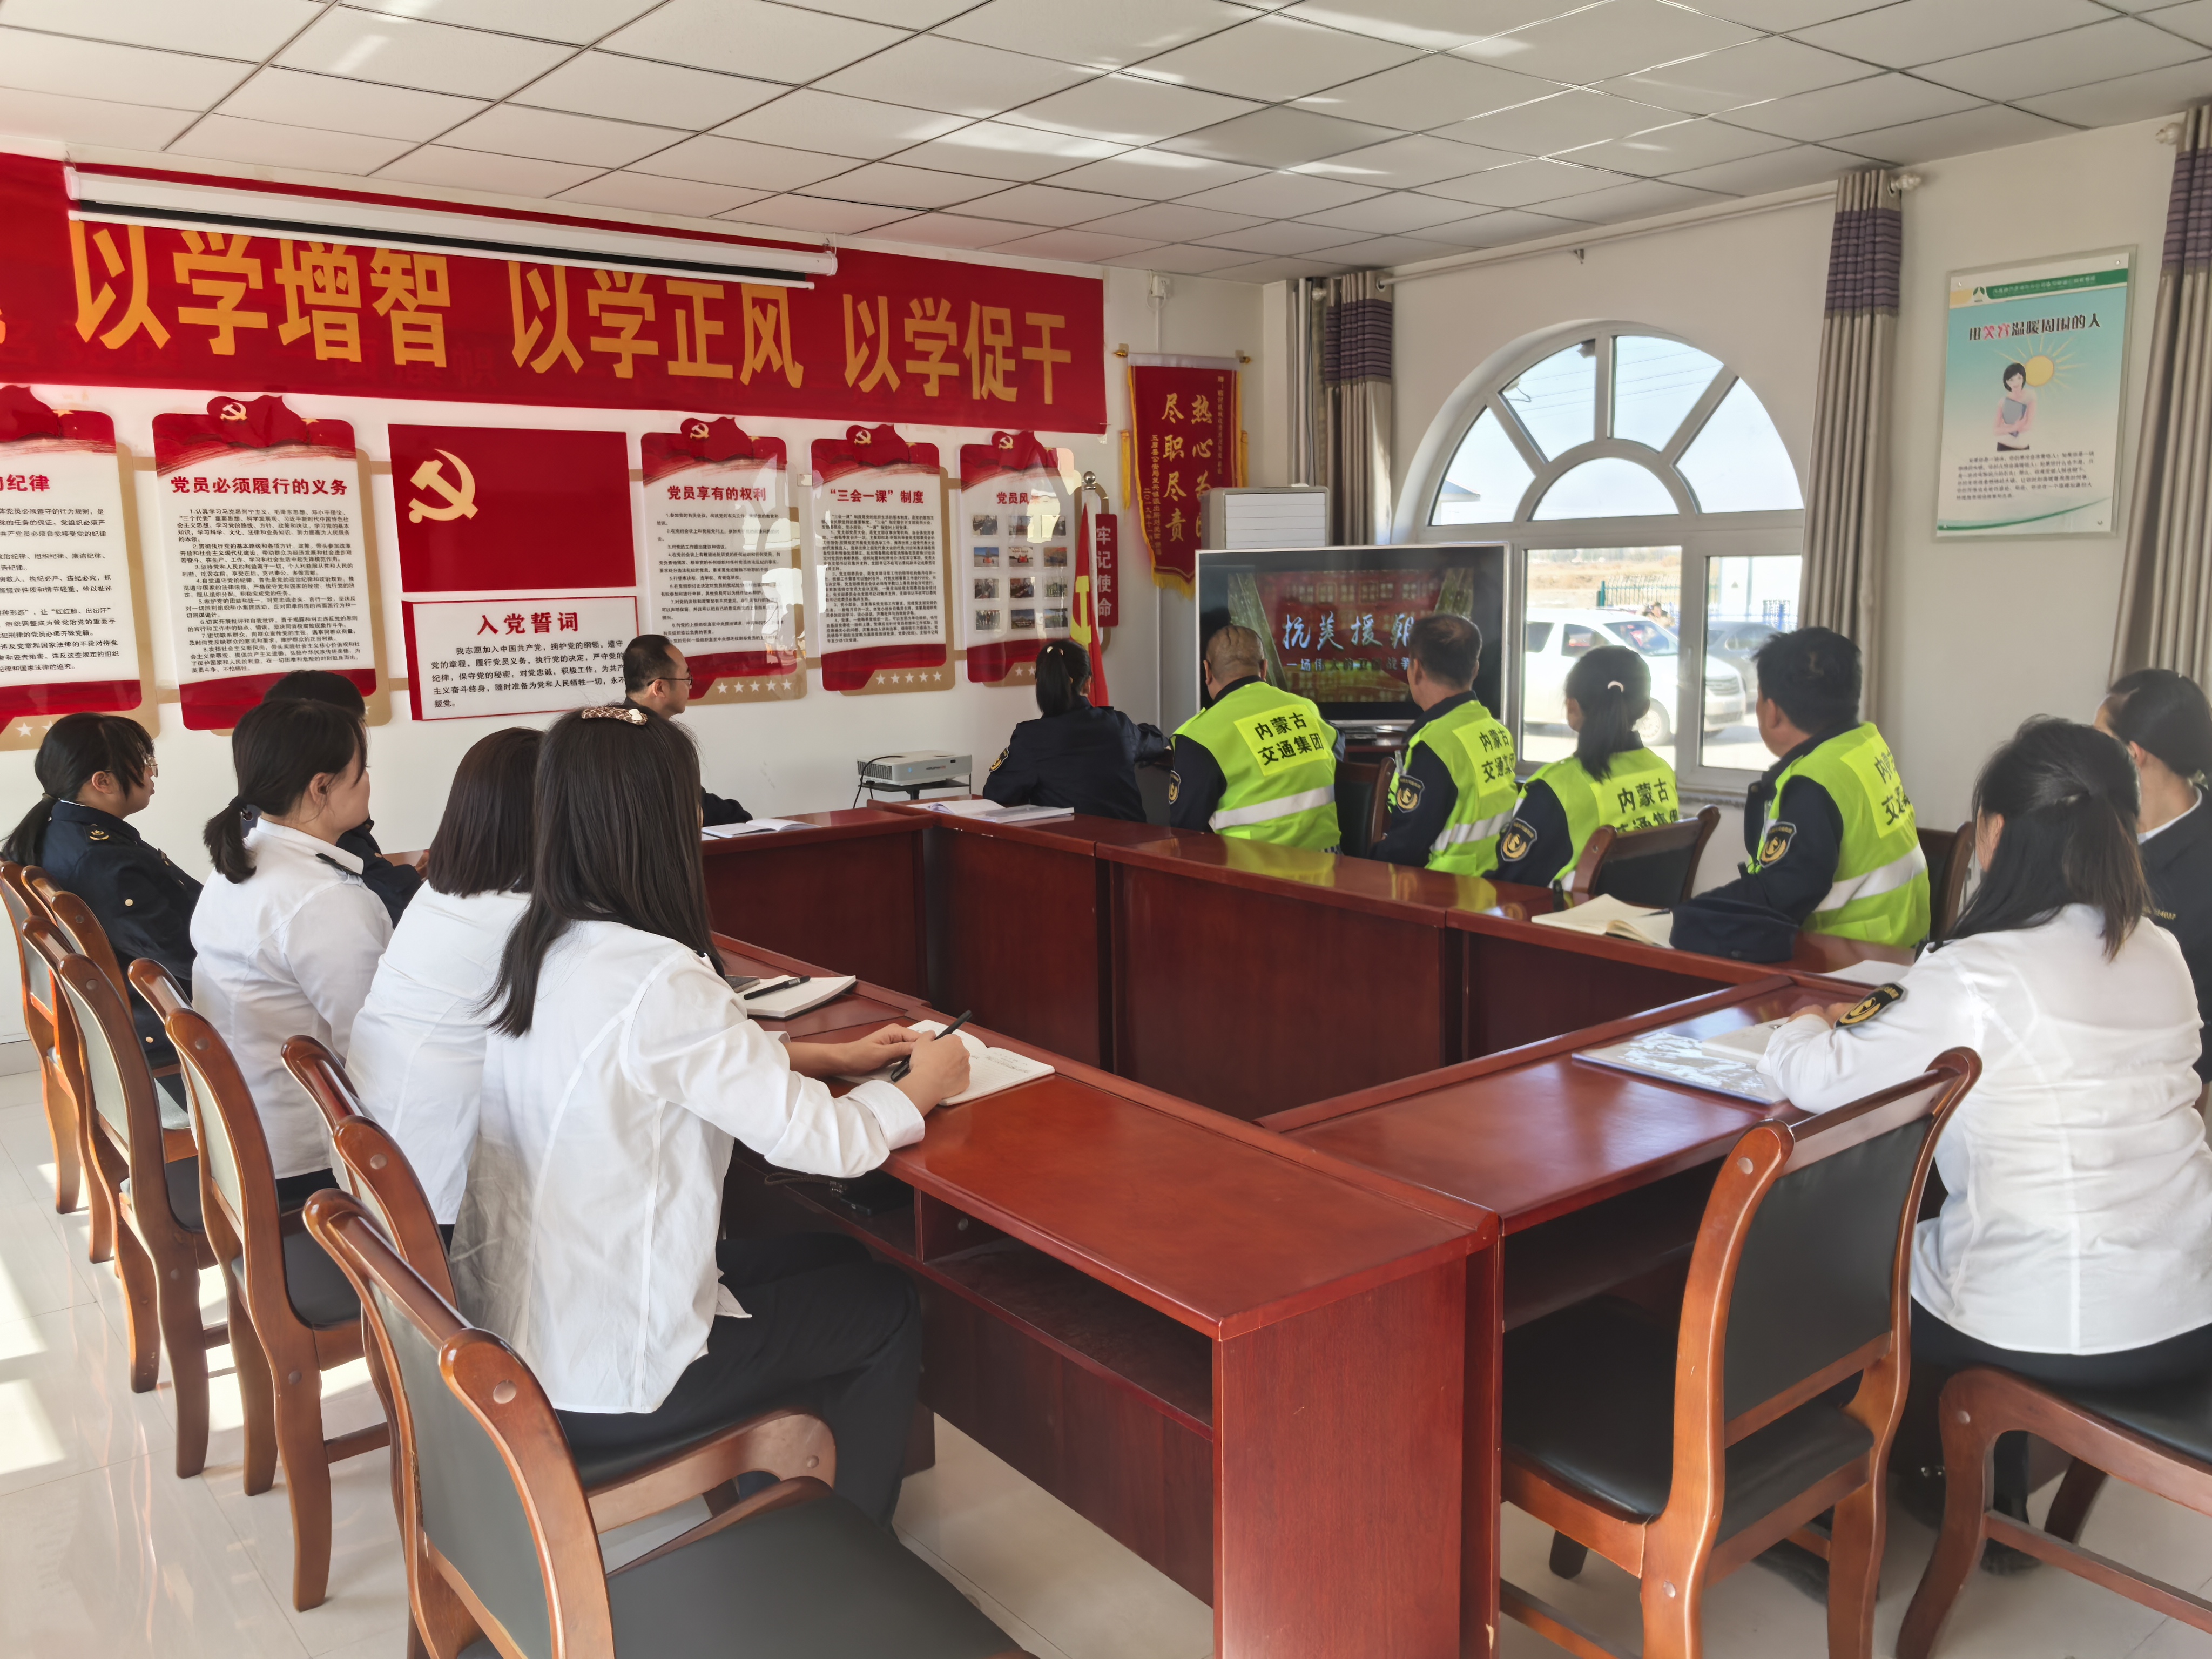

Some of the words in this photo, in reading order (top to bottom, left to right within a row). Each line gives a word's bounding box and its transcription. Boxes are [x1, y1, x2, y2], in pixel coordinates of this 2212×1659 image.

[69, 220, 450, 368] 以学增智
[508, 260, 804, 389] 以学正风
[843, 293, 1071, 405] 以学促干
[1161, 393, 1187, 541] 尽职尽责
[171, 476, 347, 495] 党员必须履行的义务
[667, 485, 766, 501] 党员享有的权利
[1096, 526, 1112, 616] 牢记使命
[477, 612, 578, 636] 入党誓词
[1282, 611, 1415, 650] 抗美援朝
[434, 700, 456, 708] 叛党。
[1254, 712, 1307, 740] 内蒙古
[1479, 727, 1509, 752] 内蒙古
[1258, 733, 1324, 766] 交通集团
[1617, 778, 1669, 814] 内蒙古
